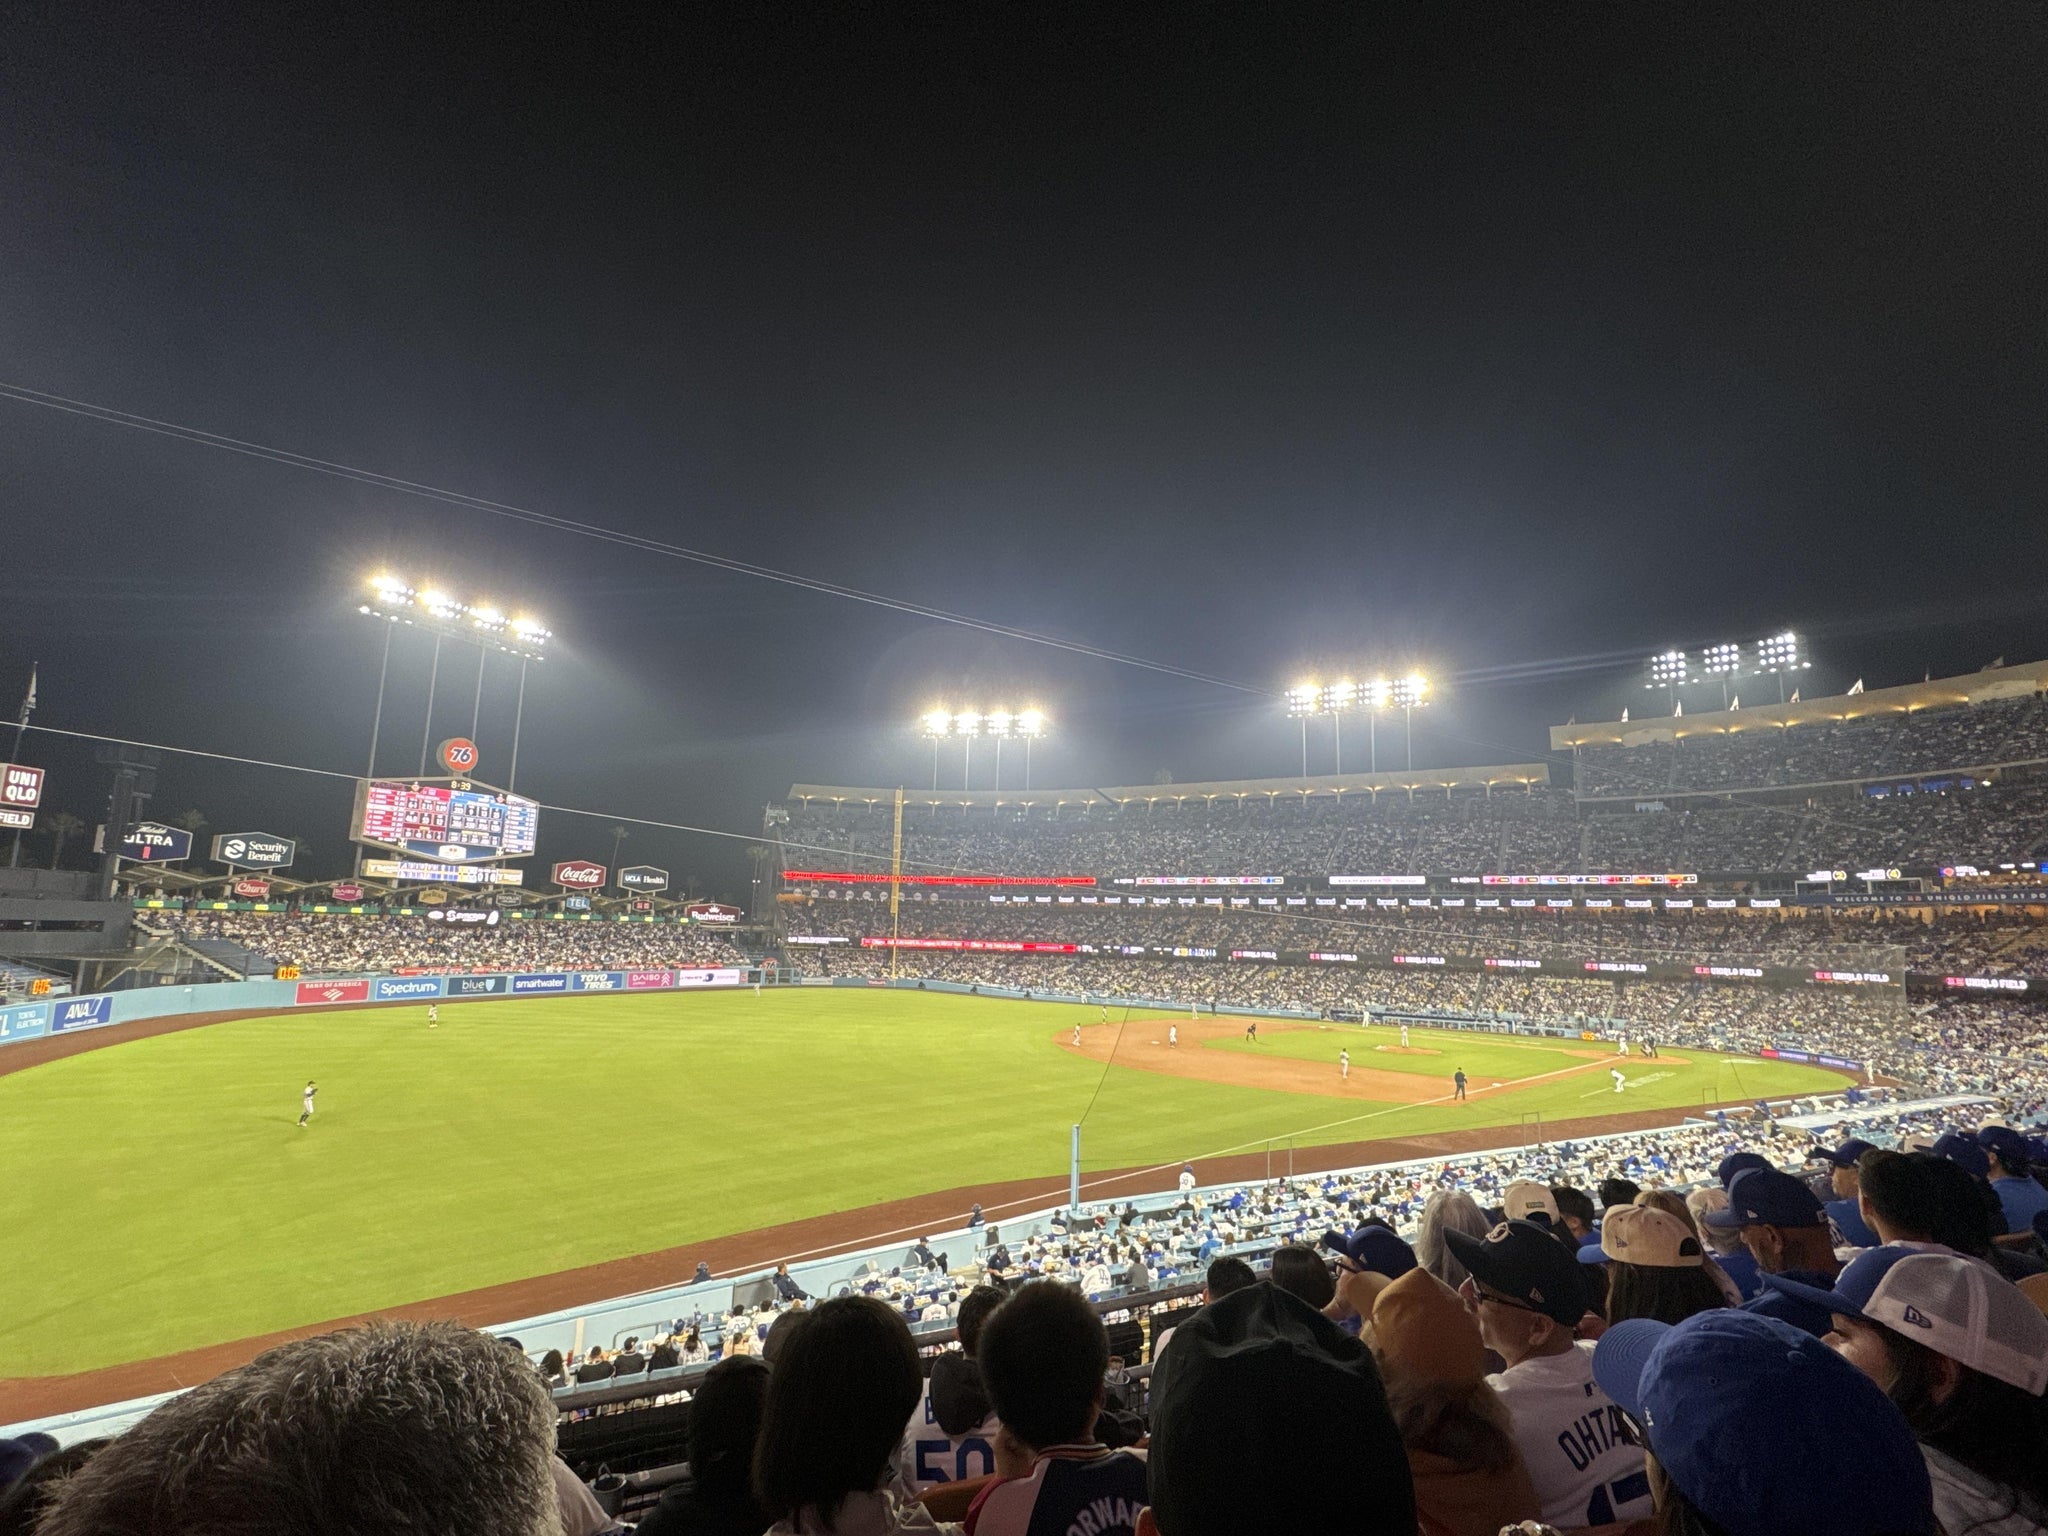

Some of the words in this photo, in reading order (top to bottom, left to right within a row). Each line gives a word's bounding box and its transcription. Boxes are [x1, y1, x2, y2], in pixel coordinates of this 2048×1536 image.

[450, 747, 472, 763] 76
[9, 770, 37, 787] UNI
[451, 781, 471, 791] 8:39
[6, 785, 37, 801] QLO
[0, 812, 30, 825] FIELD
[248, 841, 288, 854] Security
[247, 851, 283, 863] Benefit
[237, 882, 268, 894] Churu
[570, 898, 587, 907] TEL
[691, 911, 736, 921] Budweiser
[515, 979, 564, 989] smartwater
[580, 974, 608, 982] TOYO
[381, 982, 434, 996] Spectrum
[462, 979, 485, 990] blue
[583, 981, 614, 989] TIRES
[64, 1002, 90, 1020] ANA
[916, 1437, 995, 1483] 50
